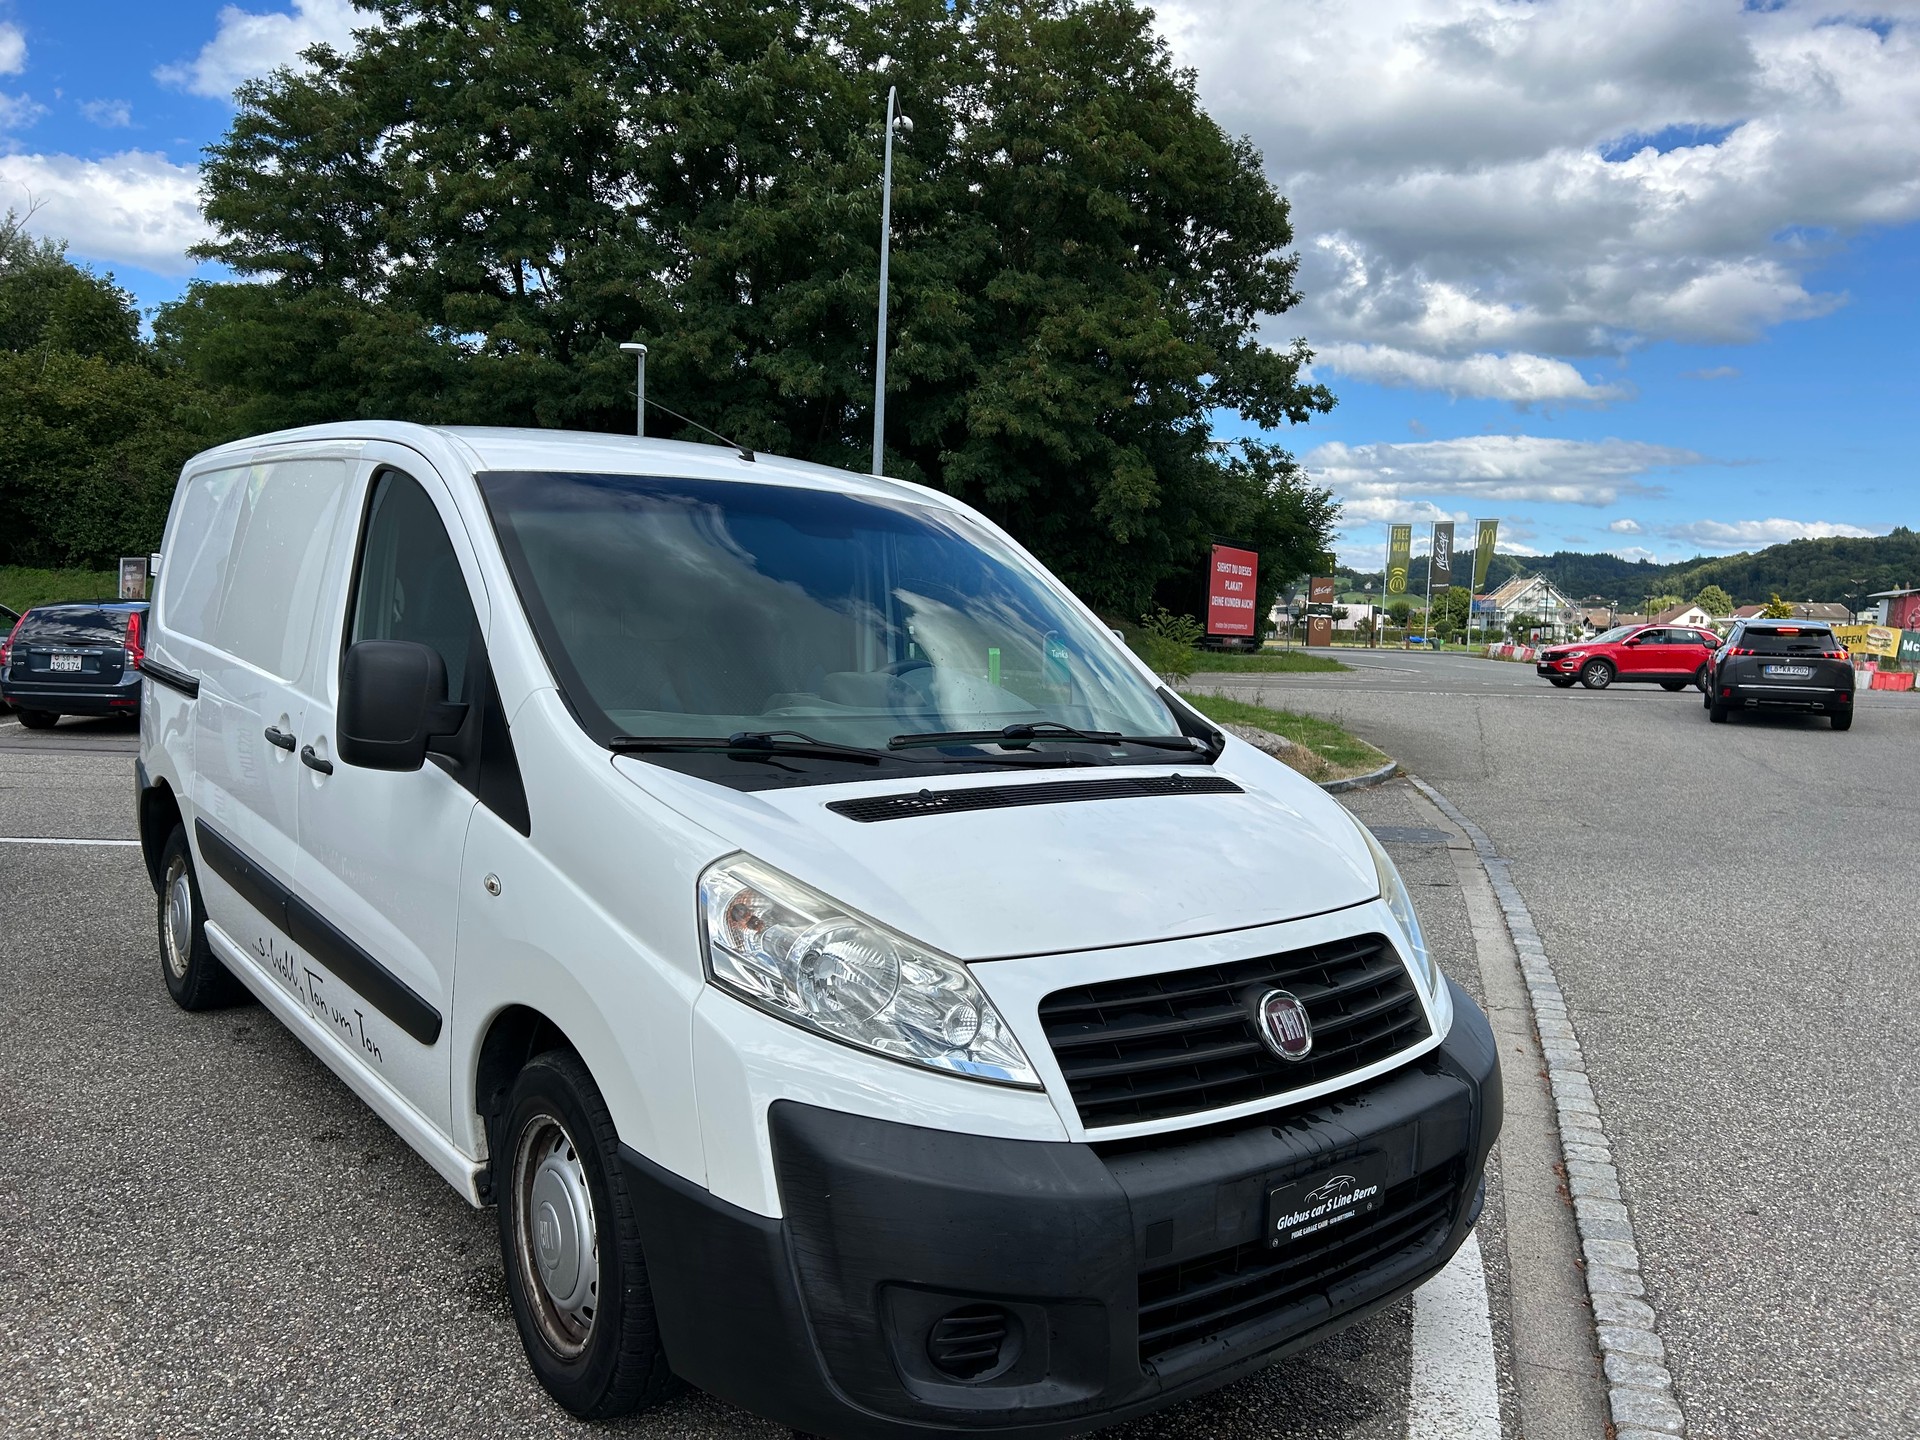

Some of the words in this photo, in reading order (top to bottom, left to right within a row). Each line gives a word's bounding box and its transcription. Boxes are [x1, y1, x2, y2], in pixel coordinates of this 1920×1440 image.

[1393, 528, 1409, 540] FREE
[1232, 564, 1238, 574] DU
[1836, 635, 1863, 645] OFFEN
[303, 966, 329, 1015] Ton
[330, 1006, 354, 1037] um
[354, 1008, 383, 1063] Ton
[1271, 1008, 1304, 1042] FIAT
[1276, 1209, 1310, 1231] Globus
[1310, 1203, 1327, 1218] car
[1326, 1199, 1333, 1212] S
[1333, 1191, 1351, 1210] Line
[1352, 1184, 1378, 1202] Berro
